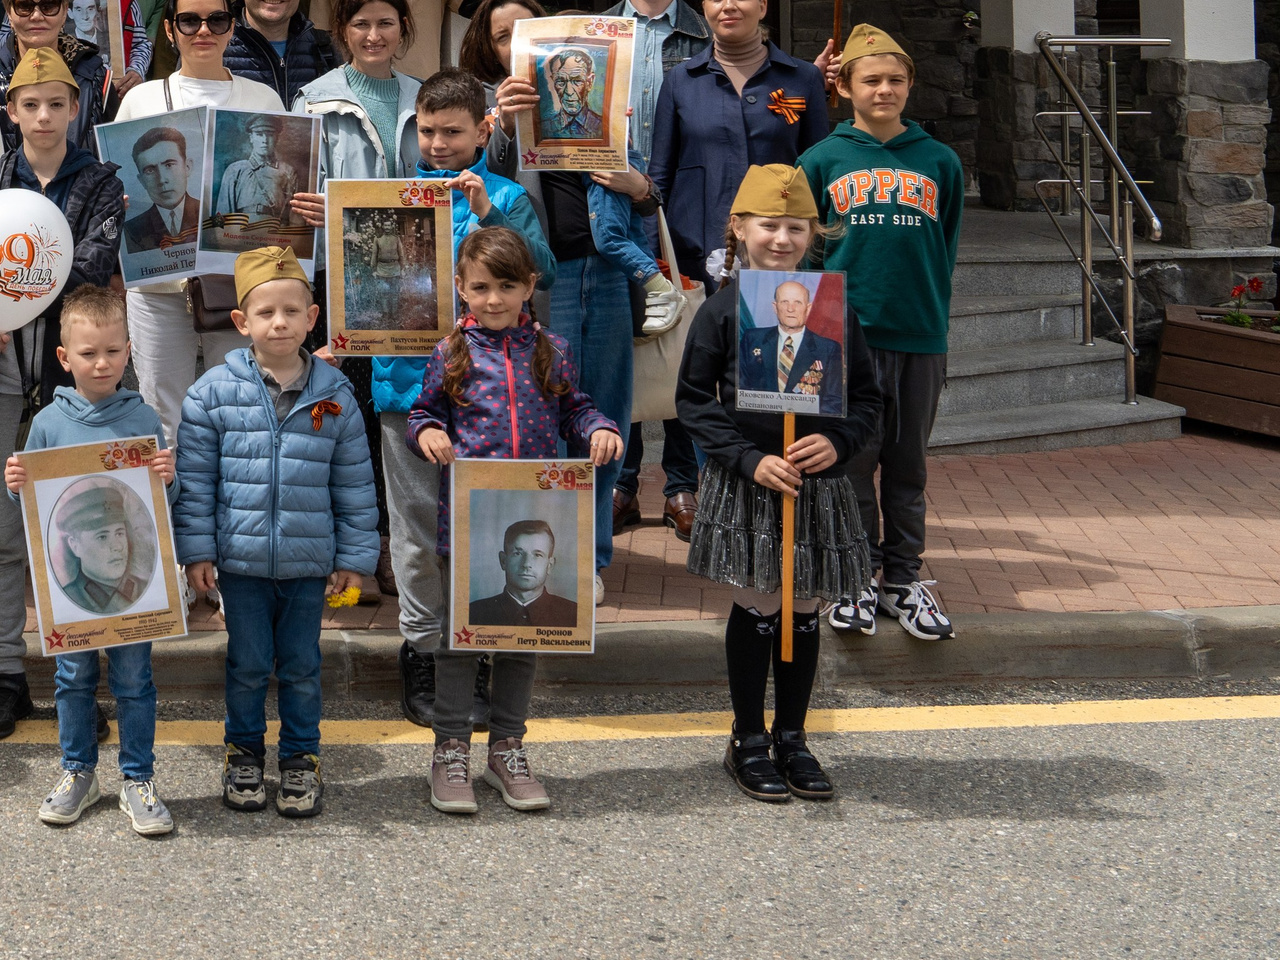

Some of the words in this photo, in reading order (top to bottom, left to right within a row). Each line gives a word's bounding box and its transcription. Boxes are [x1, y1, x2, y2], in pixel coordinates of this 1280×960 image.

[607, 24, 619, 37] 9
[423, 188, 435, 207] 9
[828, 168, 939, 222] UPPER
[850, 214, 885, 225] EAST
[893, 215, 922, 226] SIDE
[3, 233, 35, 269] 9
[163, 248, 196, 259] Чернов
[140, 261, 179, 275] Николай
[10, 267, 52, 285] мая
[739, 391, 774, 399] Яковенко
[776, 393, 816, 403] Александр
[738, 400, 783, 410] Степанович
[128, 448, 141, 467] 9
[563, 470, 576, 490] 9
[536, 628, 573, 638] Воронов
[67, 638, 91, 647] ПОЛК
[517, 637, 538, 646] Петр
[540, 638, 591, 646] Васильевич
